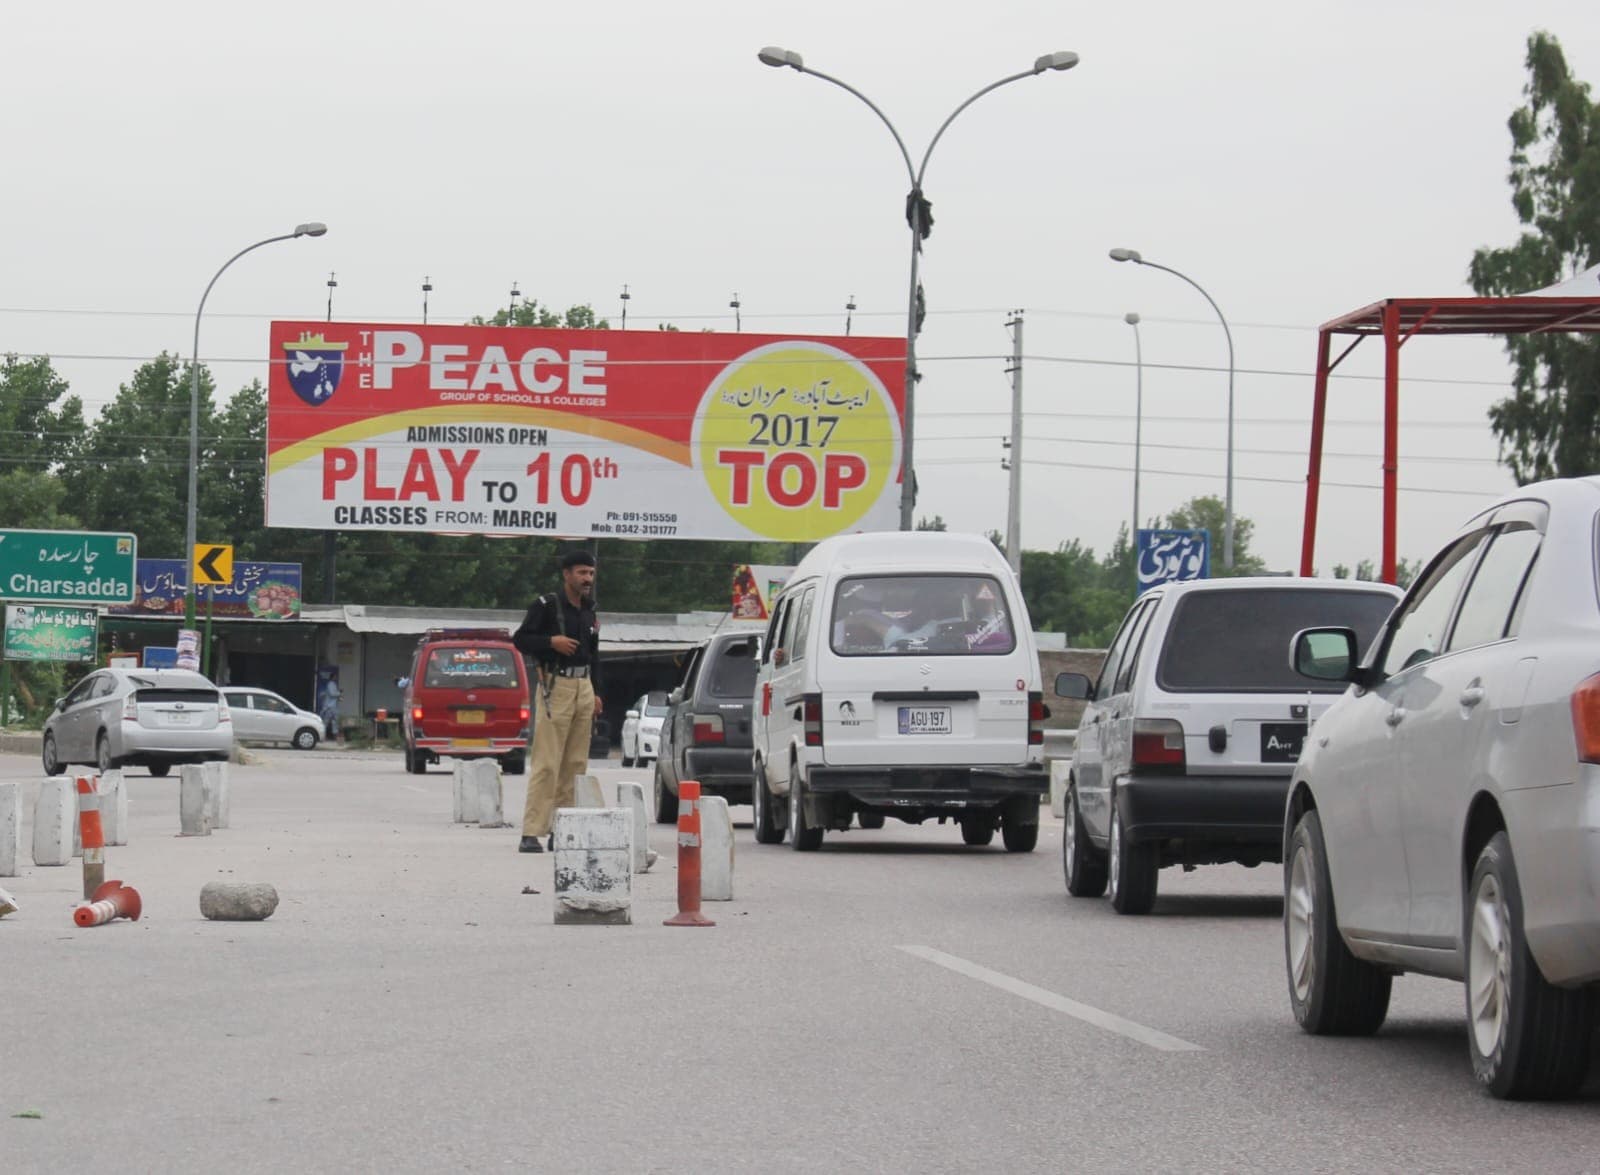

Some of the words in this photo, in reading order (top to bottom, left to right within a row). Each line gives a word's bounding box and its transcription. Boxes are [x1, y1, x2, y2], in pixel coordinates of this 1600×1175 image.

[359, 331, 371, 389] THE
[373, 330, 608, 395] PEACE
[440, 392, 475, 401] GROUP
[478, 392, 491, 402] OF
[494, 393, 541, 404] SCHOOLS
[543, 395, 550, 404] &
[553, 395, 606, 406] COLLEGES
[407, 426, 504, 444] ADMISSIONS
[508, 428, 547, 446] OPEN
[748, 413, 839, 448] 2017
[322, 447, 480, 503] PLAY
[482, 481, 518, 503] TO
[719, 450, 866, 508] TOP
[334, 506, 428, 525] CLASSES
[435, 511, 488, 525] FROM:
[492, 509, 557, 529] MARCH
[591, 523, 613, 533] Mob:
[607, 511, 621, 520] Ph:
[38, 540, 99, 575] چارسدہ
[9, 573, 128, 596] Charsadda
